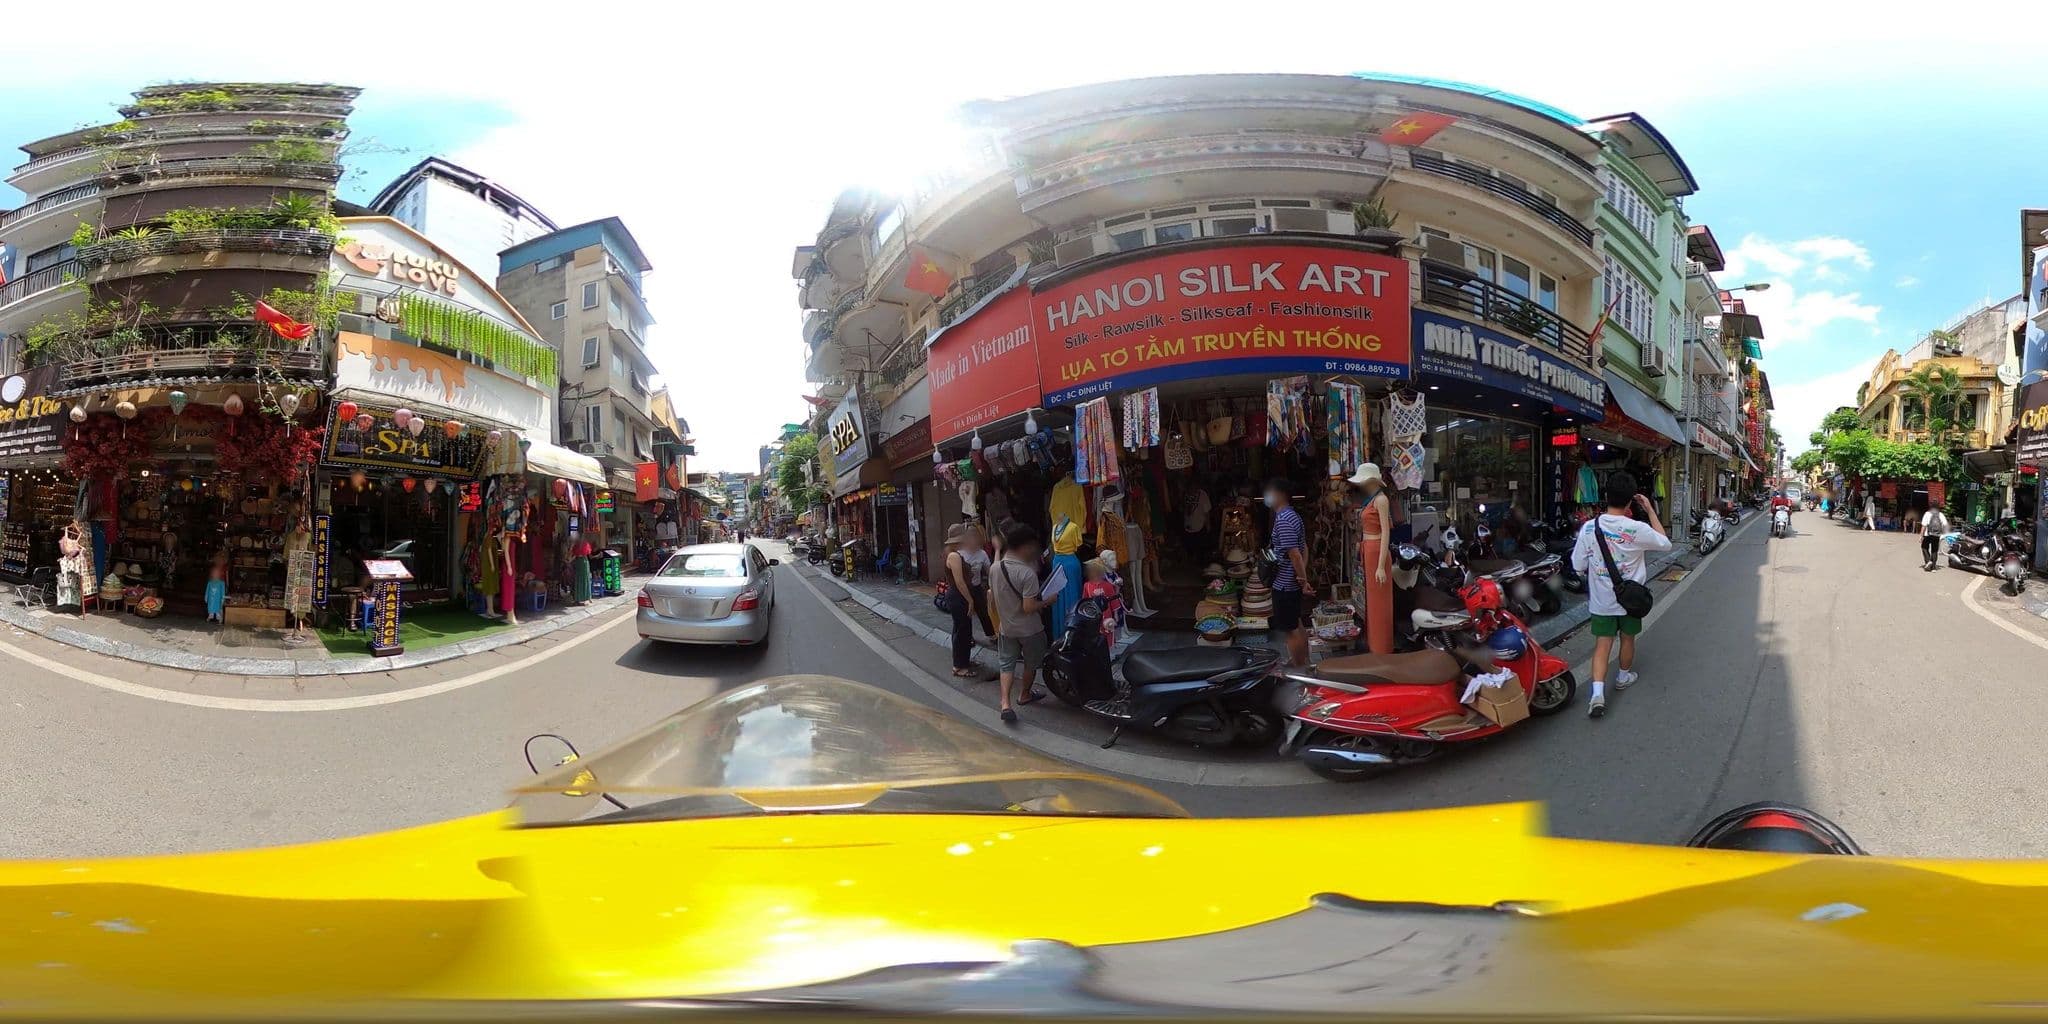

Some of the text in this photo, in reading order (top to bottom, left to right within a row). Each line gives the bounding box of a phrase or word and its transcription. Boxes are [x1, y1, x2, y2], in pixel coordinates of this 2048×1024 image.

[393, 263, 457, 296] LOVE
[1045, 261, 1390, 332] HANOI SILK ART
[1061, 323, 1382, 381] LỤA TƠ TẰM TRUYỀN THỐNG
[1064, 331, 1090, 350] Silk
[1102, 314, 1166, 339] Rawsilk
[1180, 302, 1253, 323] Silkscaf
[1270, 302, 1373, 321] Fashionsilk
[1423, 321, 1477, 361] NHÀ
[1478, 336, 1539, 379] THUỐC
[931, 325, 1030, 392] Made in Vietnam
[1325, 361, 1338, 370] ĐT
[1344, 362, 1401, 375] 0986.889.758
[831, 411, 858, 455] SPA
[316, 519, 328, 600] MASSAGE
[384, 584, 397, 645] MASSAGE
